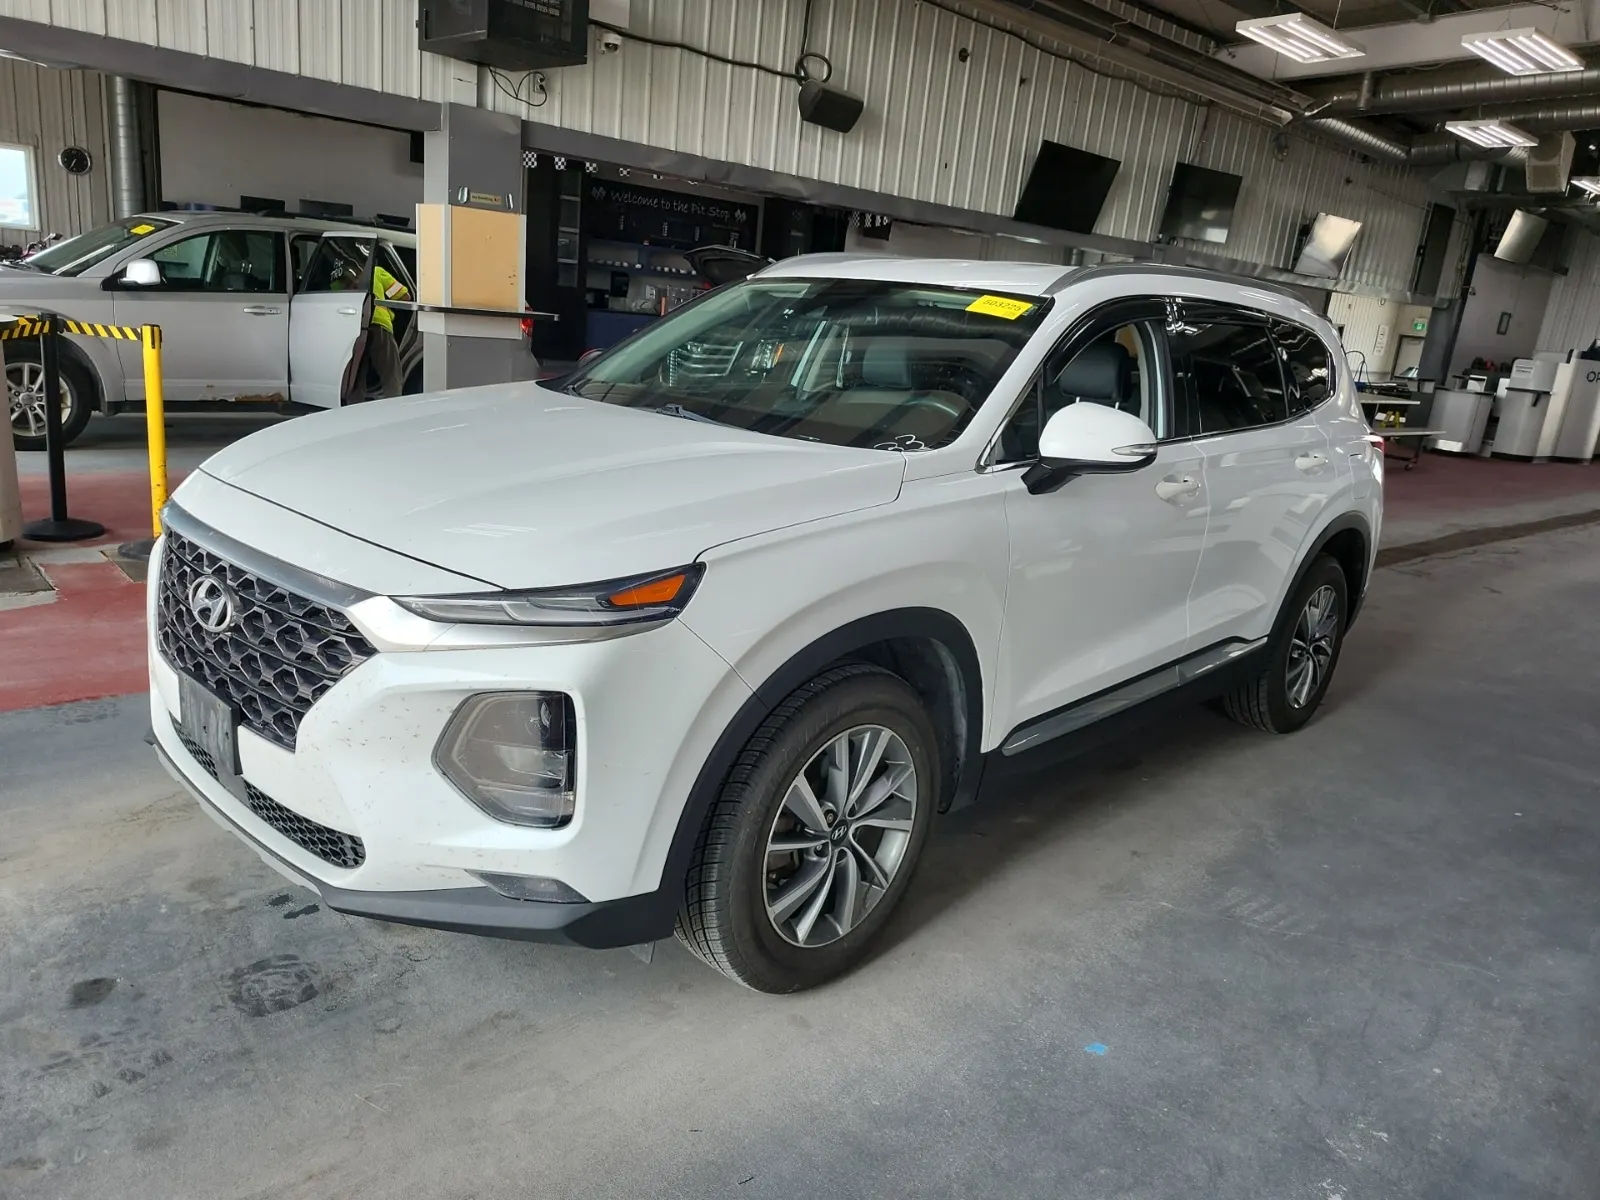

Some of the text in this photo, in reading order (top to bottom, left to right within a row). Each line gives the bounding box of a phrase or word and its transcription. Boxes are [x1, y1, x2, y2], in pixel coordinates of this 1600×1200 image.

[611, 191, 731, 219] Welcome to the Pit Stop
